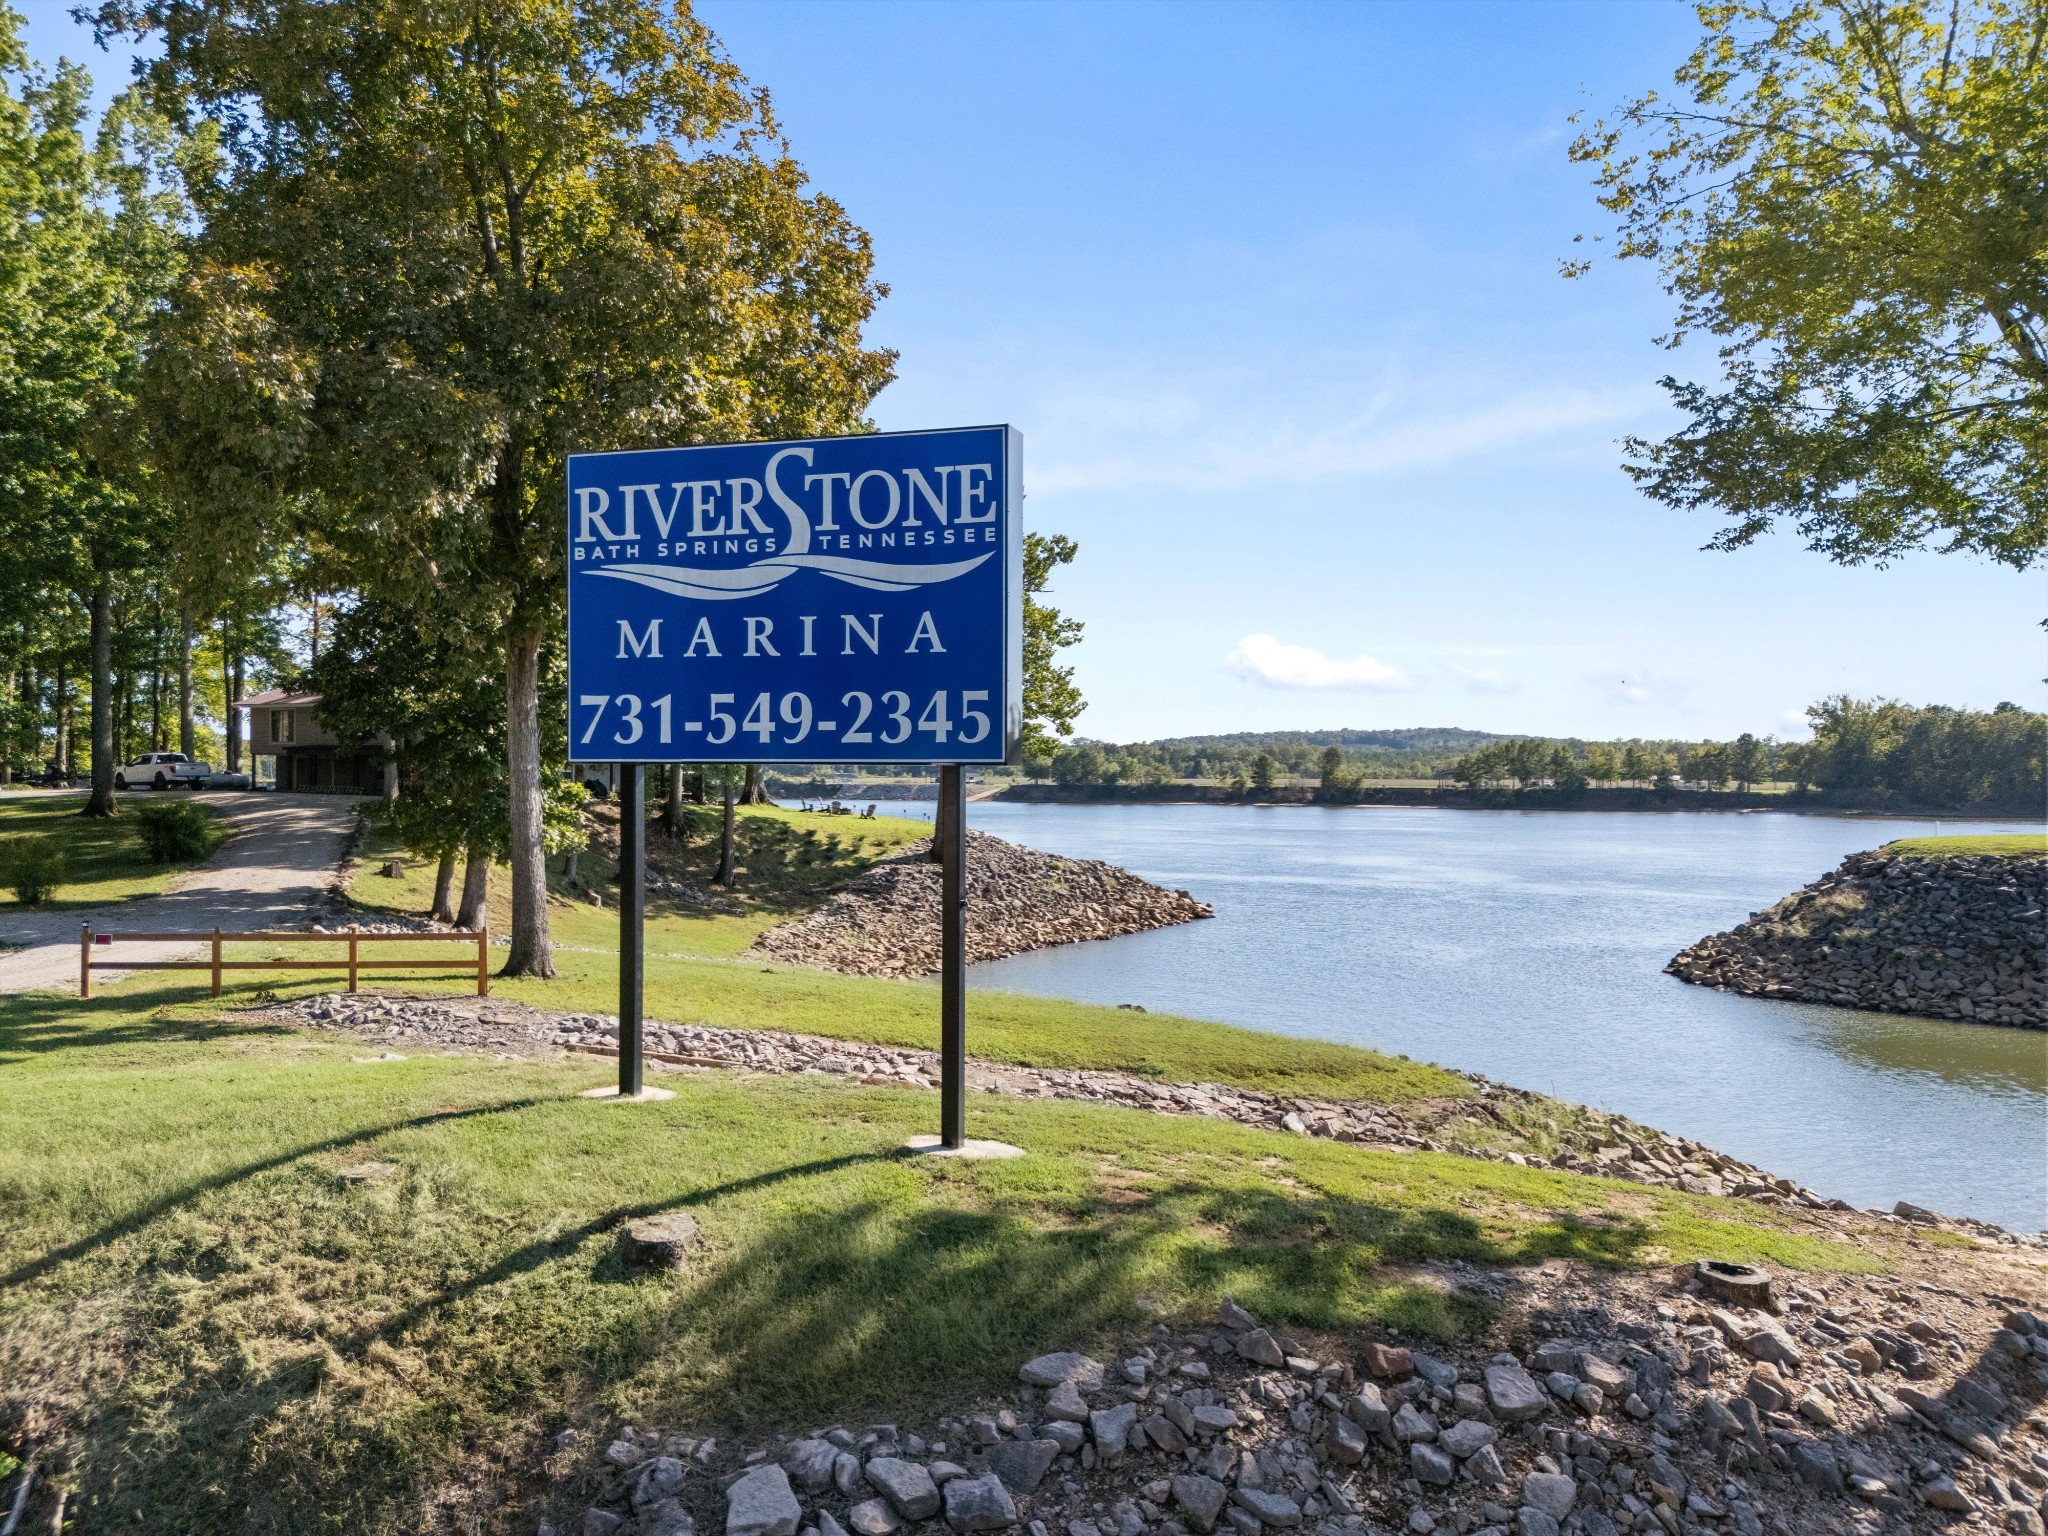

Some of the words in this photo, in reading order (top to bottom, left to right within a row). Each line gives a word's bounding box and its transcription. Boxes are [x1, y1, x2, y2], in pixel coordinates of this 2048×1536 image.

[574, 447, 997, 554] RIVERSTONE
[574, 543, 640, 561] BATH
[658, 538, 777, 557] SPRINGS
[819, 527, 997, 550] TENNESSEE
[616, 610, 947, 659] MARINA
[580, 690, 991, 745] 731-549-2345
